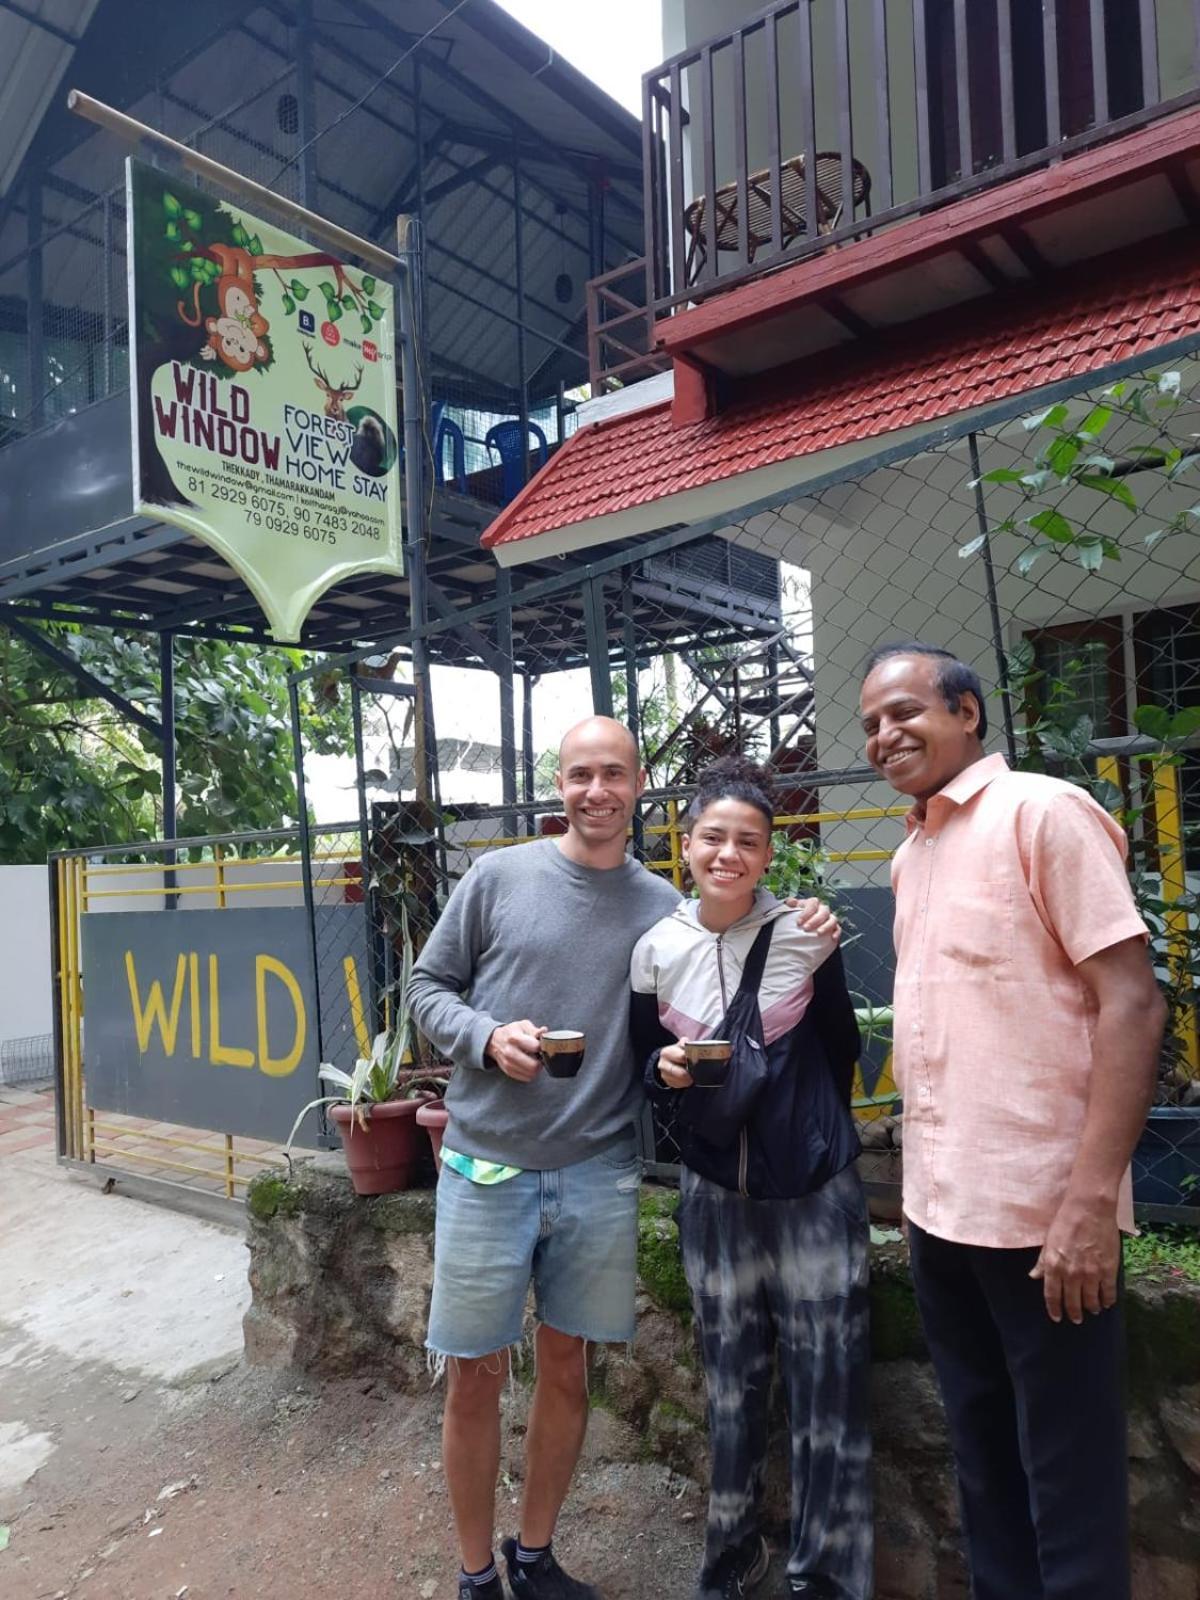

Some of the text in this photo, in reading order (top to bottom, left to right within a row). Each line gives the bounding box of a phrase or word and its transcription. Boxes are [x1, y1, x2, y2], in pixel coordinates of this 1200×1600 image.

[172, 360, 250, 424] WILD
[154, 395, 280, 471] WINDOW
[284, 404, 355, 444] FOREST
[286, 428, 350, 467] VIEW
[222, 460, 260, 480] THEKKADY
[286, 455, 388, 502] HOME STAY
[188, 476, 380, 541] 81 2929 6075, 90 7483 2048
[243, 509, 337, 545] 79 0929 6075
[124, 950, 307, 1078] WILD
